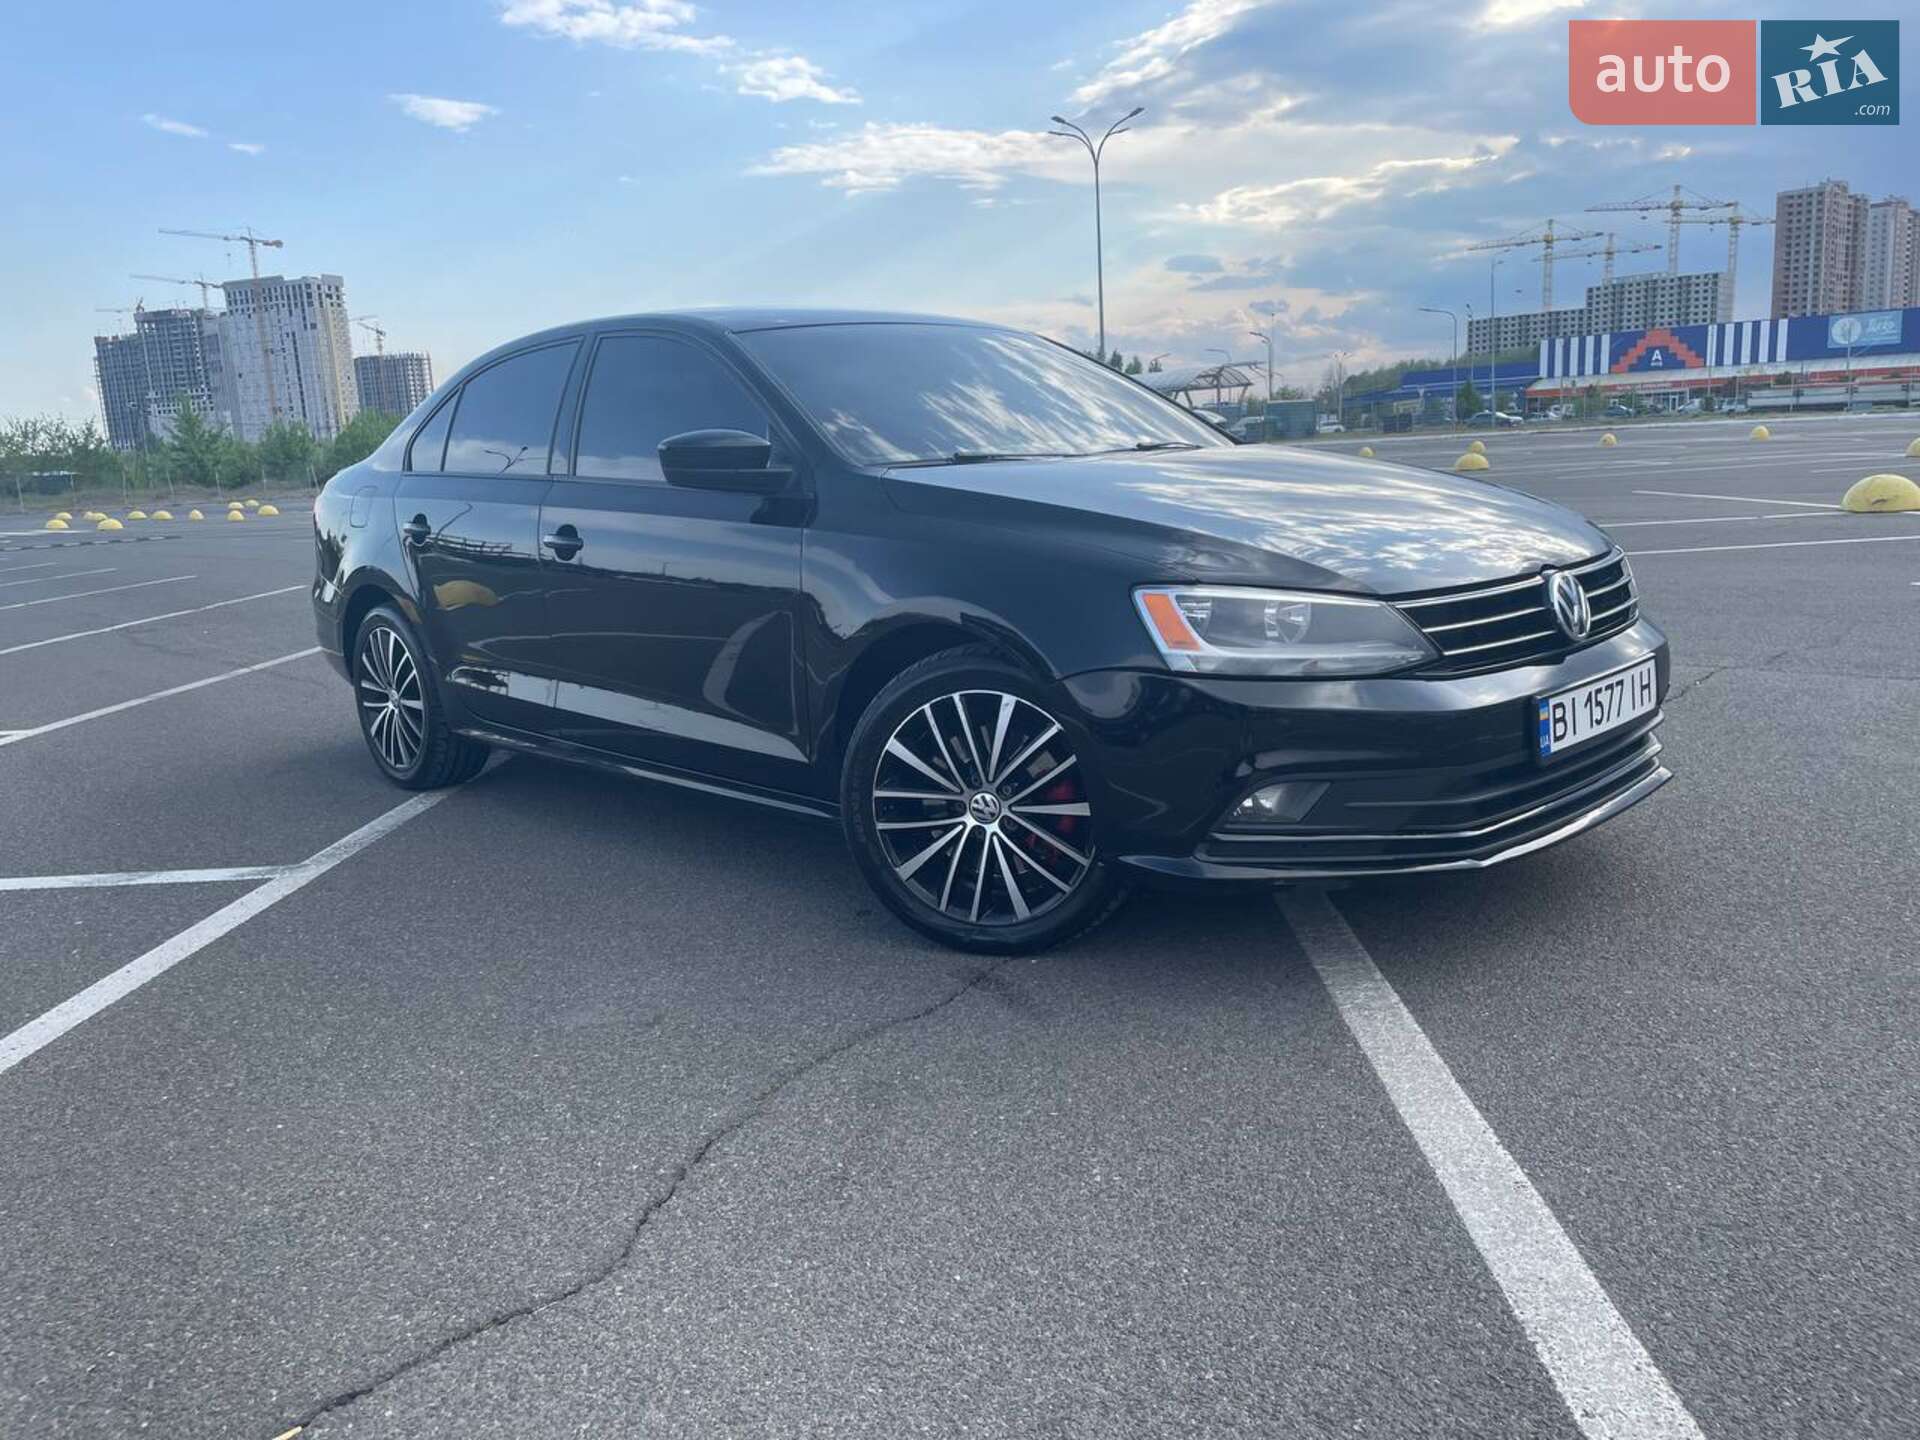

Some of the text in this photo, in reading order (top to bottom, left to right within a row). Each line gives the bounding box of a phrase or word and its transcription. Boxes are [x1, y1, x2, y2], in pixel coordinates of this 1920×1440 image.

[1552, 667, 1652, 743] BI 1577 IH
